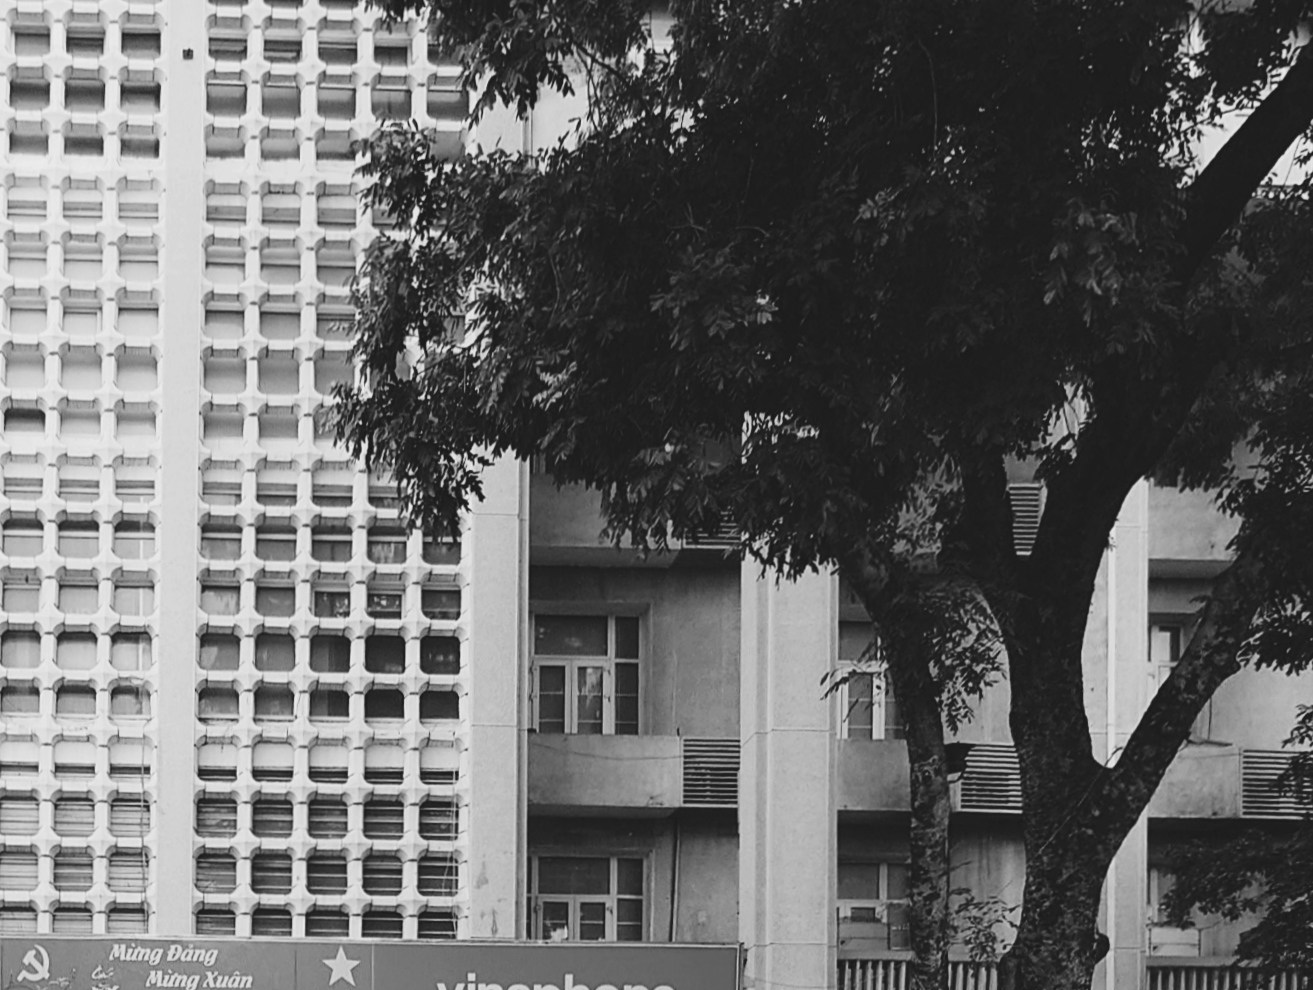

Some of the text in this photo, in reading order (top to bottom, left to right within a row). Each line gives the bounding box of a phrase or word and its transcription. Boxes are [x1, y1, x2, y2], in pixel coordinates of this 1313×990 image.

[109, 943, 218, 966] Mừng Đảng
[202, 971, 253, 989] Xuân
